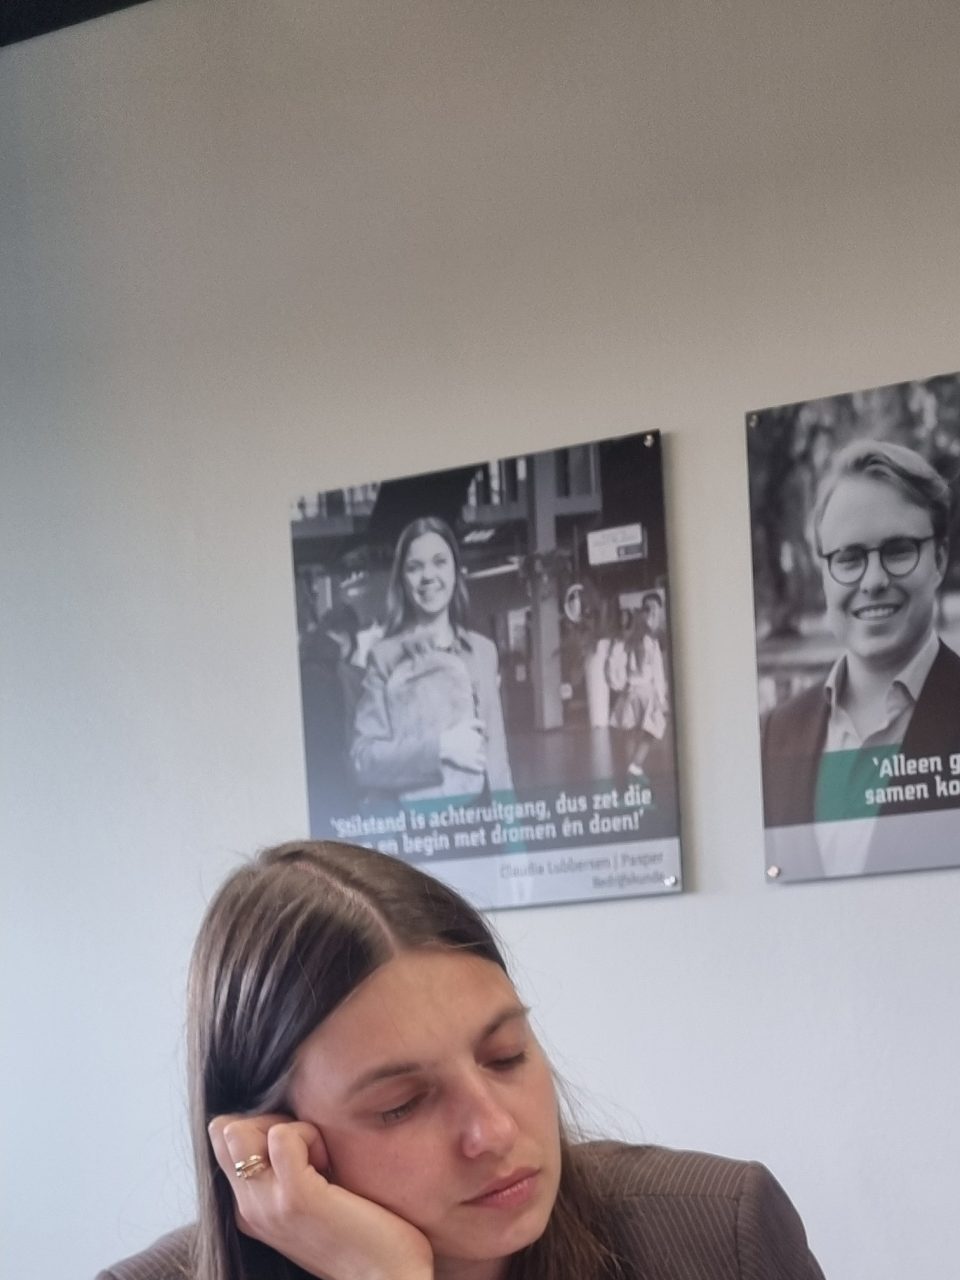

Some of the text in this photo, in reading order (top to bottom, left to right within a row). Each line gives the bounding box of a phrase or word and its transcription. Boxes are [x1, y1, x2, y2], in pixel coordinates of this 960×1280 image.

[411, 808, 426, 830] is
[429, 798, 551, 828] achteruitgang,
[555, 792, 587, 815] dus
[593, 789, 618, 810] zet
[624, 784, 652, 806] die
[865, 782, 928, 805] samen
[403, 832, 450, 856] begin
[454, 826, 487, 848] met
[491, 821, 557, 844] dromen
